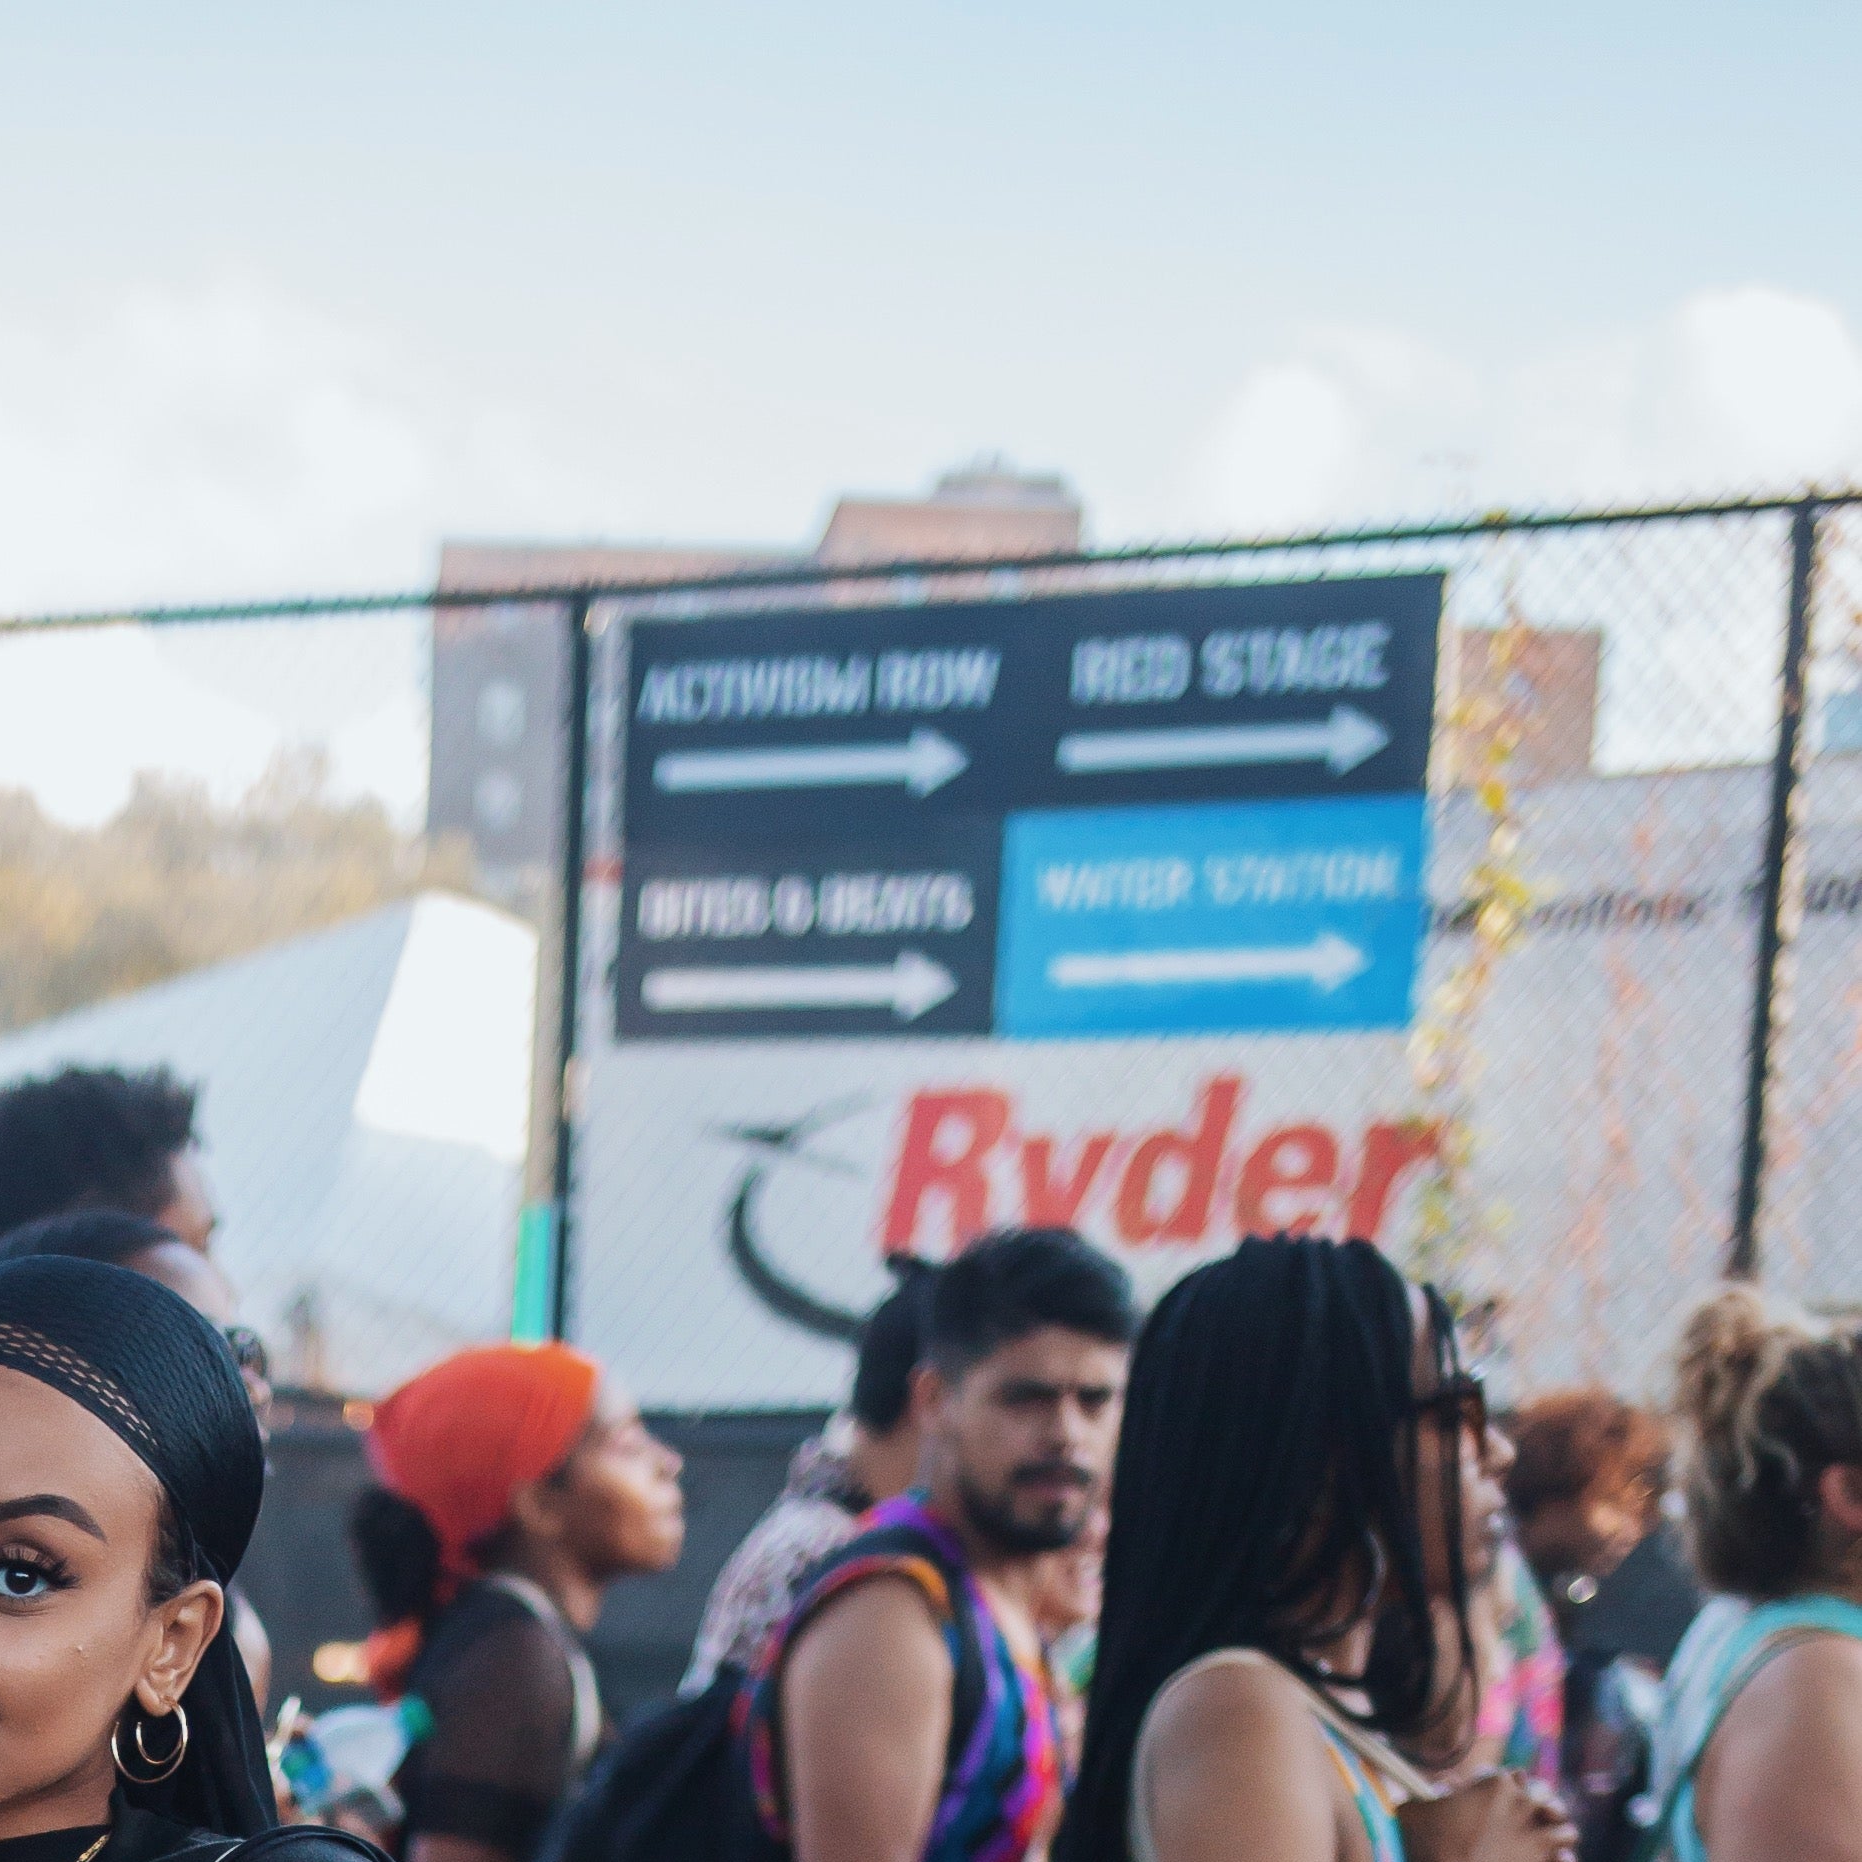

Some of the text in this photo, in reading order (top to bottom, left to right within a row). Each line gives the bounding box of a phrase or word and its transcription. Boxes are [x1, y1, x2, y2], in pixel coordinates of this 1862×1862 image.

[875, 644, 1003, 713] ROW
[1070, 620, 1393, 704] RED STAGE
[877, 1069, 1448, 1262] Ryder
